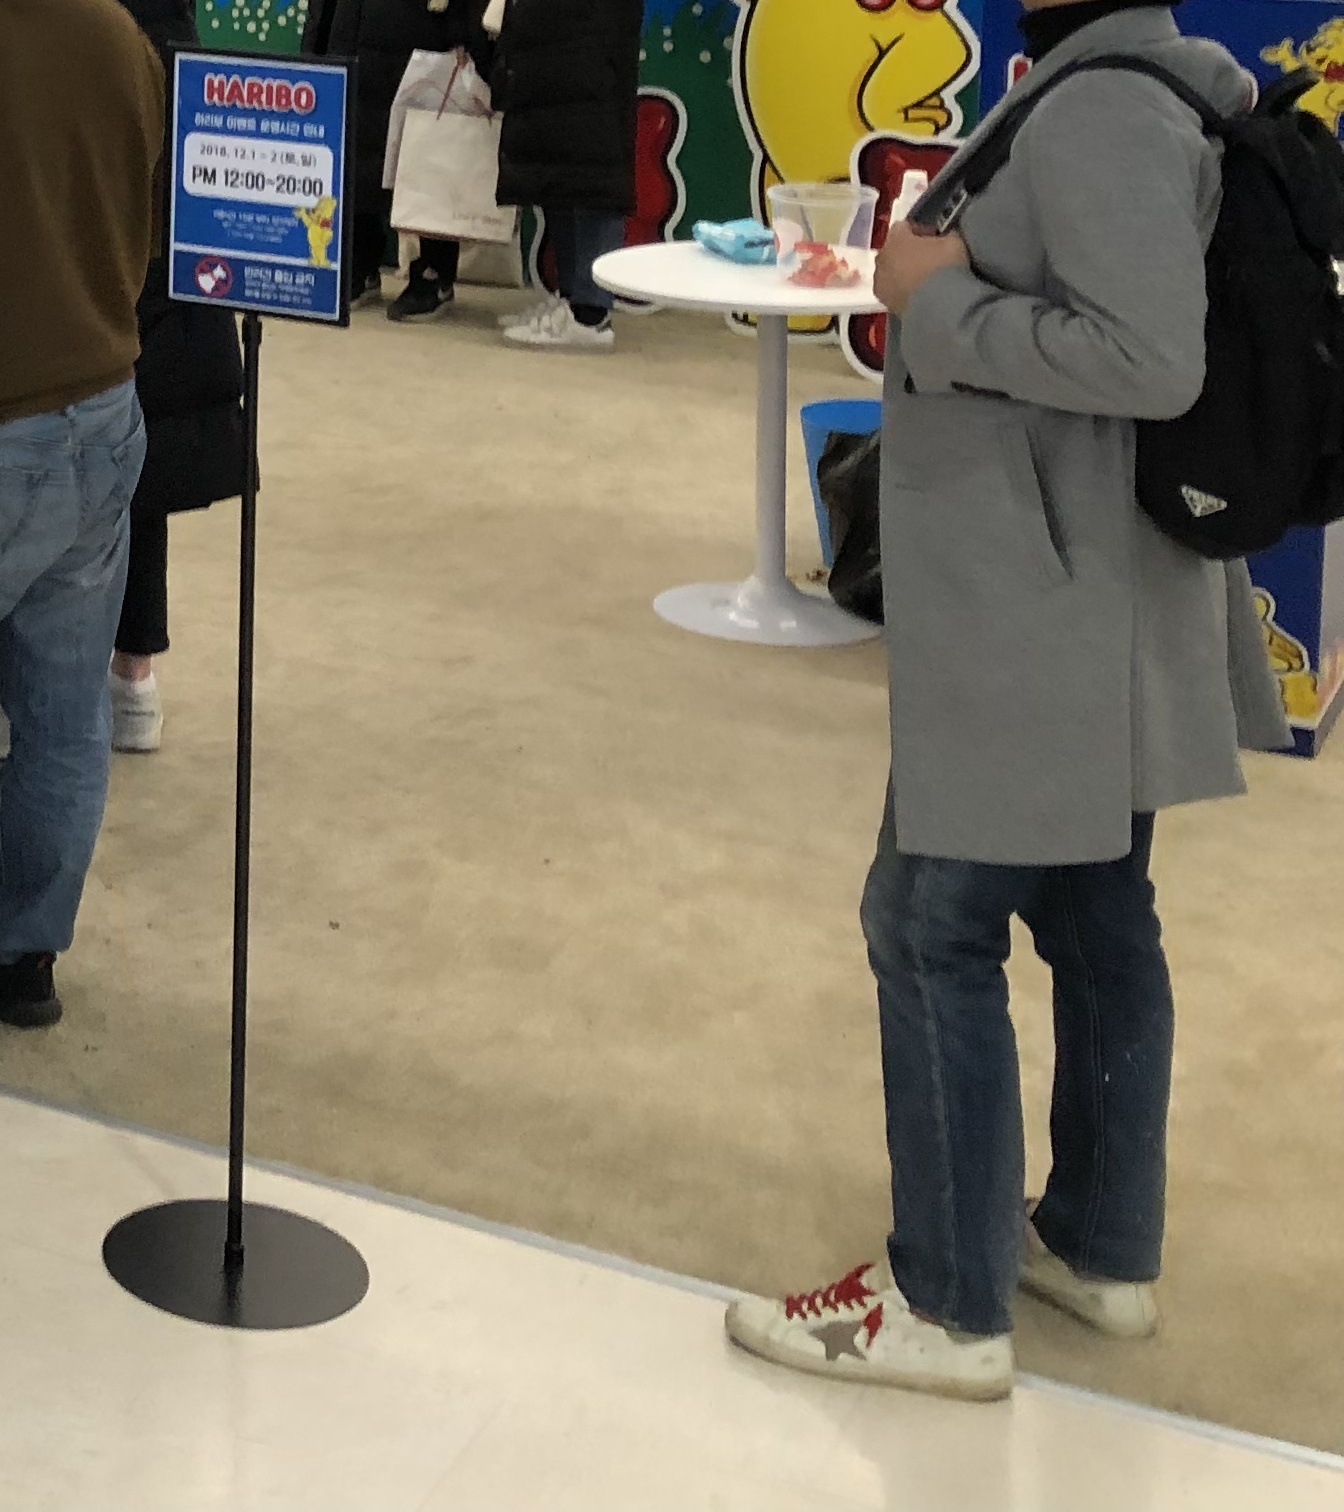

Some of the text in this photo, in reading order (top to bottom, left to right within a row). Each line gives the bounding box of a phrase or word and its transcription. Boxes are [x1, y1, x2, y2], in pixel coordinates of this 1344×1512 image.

[205, 75, 315, 113] HARIBO
[192, 165, 324, 197] PM 12:00~20:00
